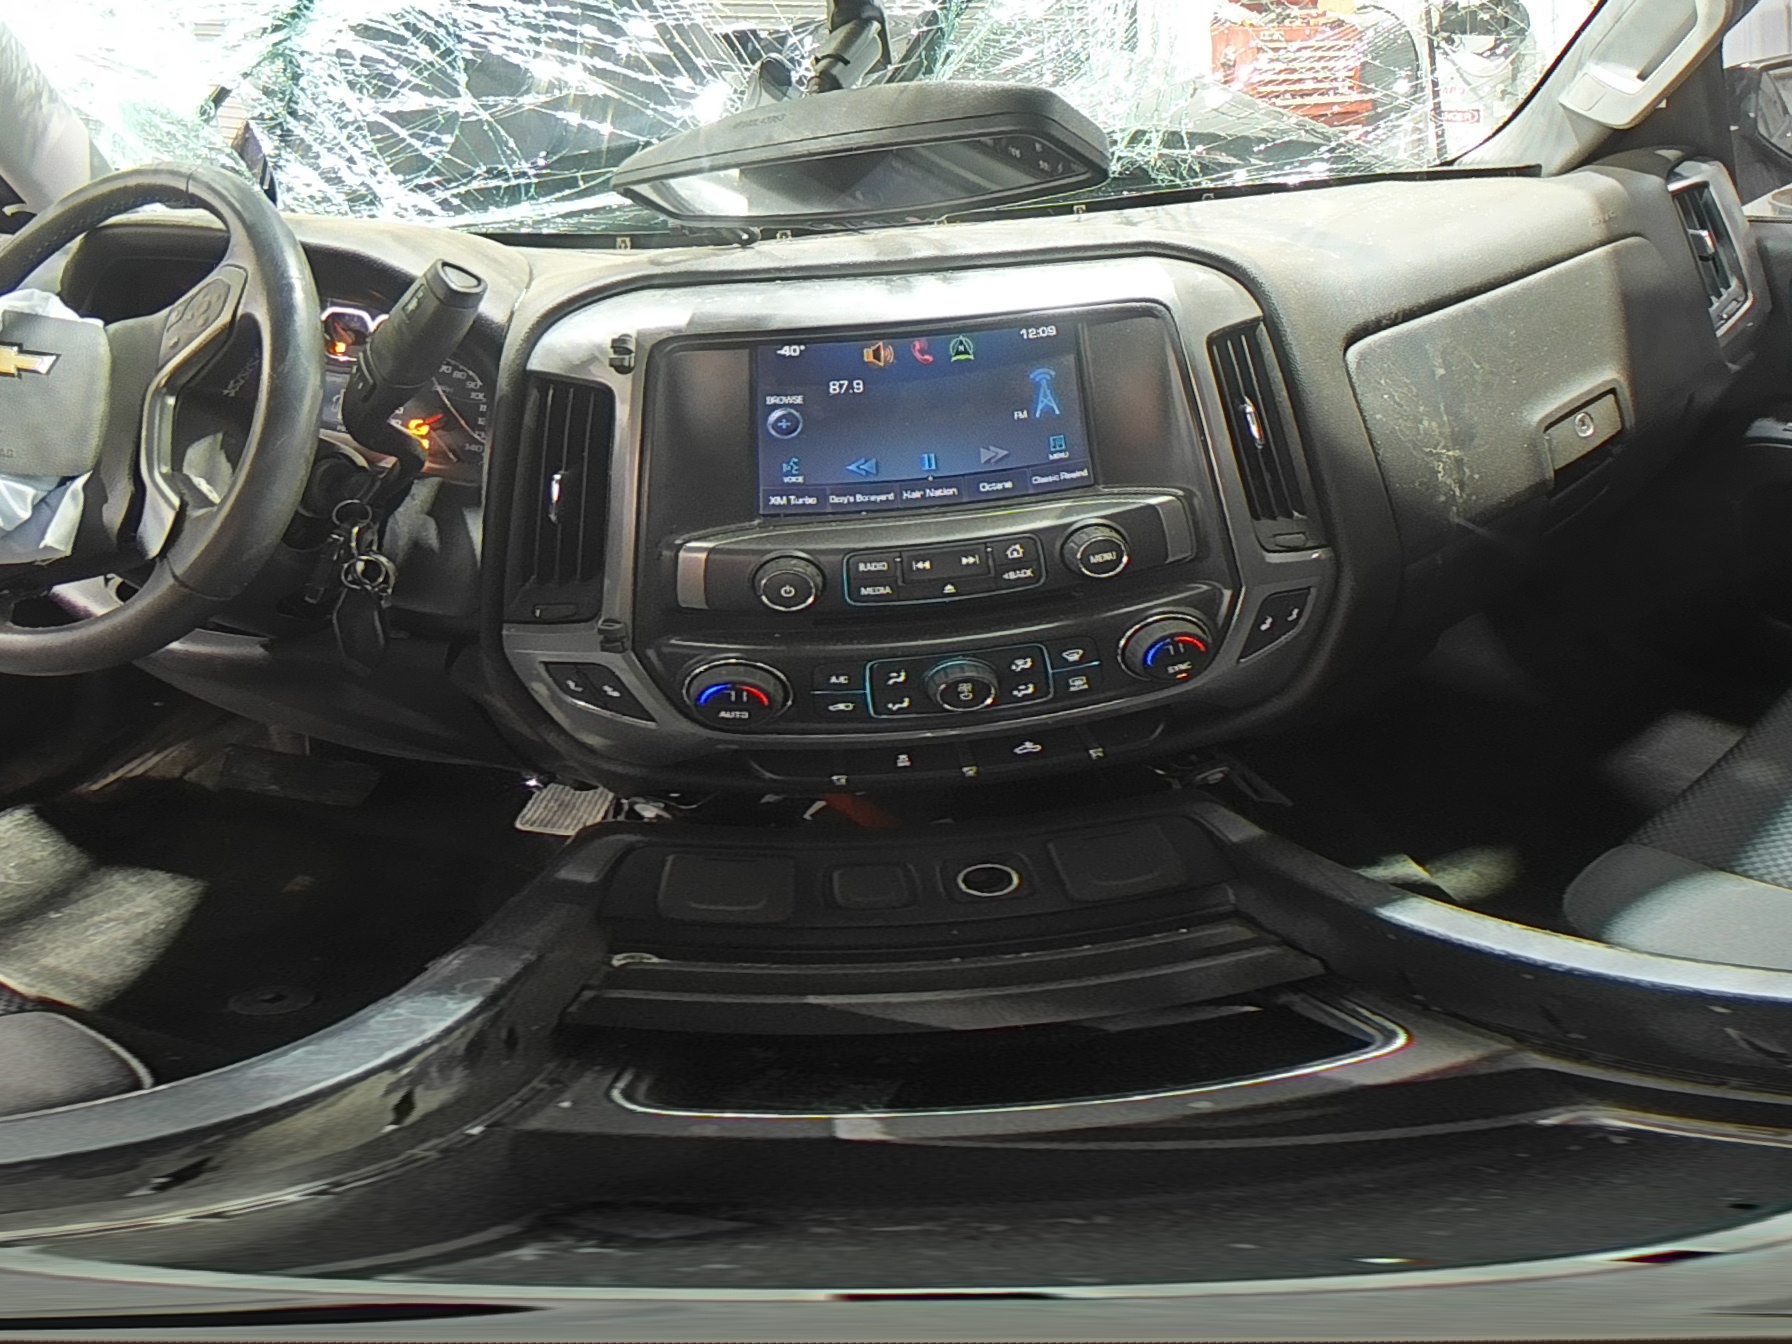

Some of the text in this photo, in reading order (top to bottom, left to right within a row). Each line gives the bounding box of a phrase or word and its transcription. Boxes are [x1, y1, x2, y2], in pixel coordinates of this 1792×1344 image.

[1020, 325, 1057, 340] 12:09
[439, 365, 452, 374] 70
[453, 371, 467, 379] 80
[466, 381, 481, 389] 90
[829, 379, 864, 394] 87.9
[765, 395, 805, 406] BROWSE
[1013, 409, 1028, 420] FM
[1049, 451, 1070, 461] MENU
[782, 475, 805, 484] VOICE
[1031, 467, 1089, 485] Classic Rewind
[979, 480, 1014, 492] Octane
[902, 486, 959, 500] Hair Nation
[768, 494, 818, 506] XM Turbo
[1089, 551, 1117, 565] MENU
[858, 561, 888, 573] RADIO
[1009, 568, 1035, 580] BACK
[859, 586, 893, 596] MEDIA
[1166, 660, 1193, 674] SYNC
[718, 709, 749, 720] AUTO
